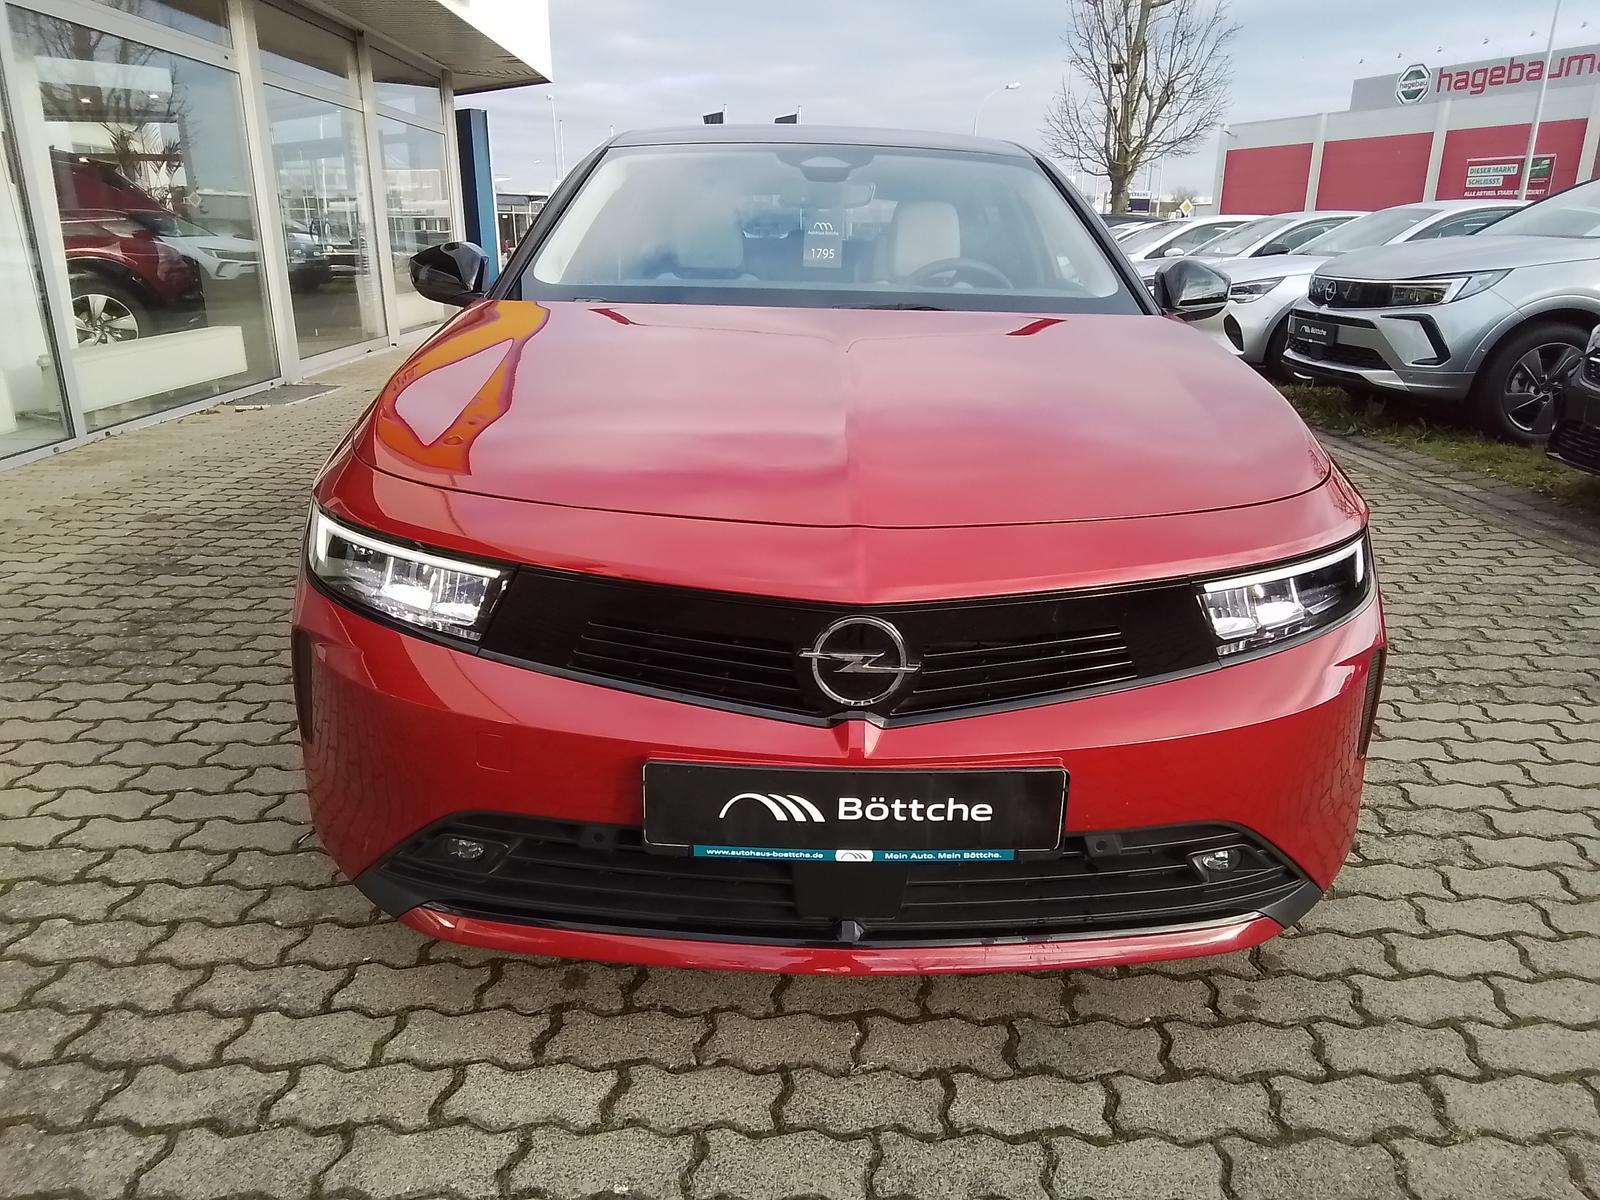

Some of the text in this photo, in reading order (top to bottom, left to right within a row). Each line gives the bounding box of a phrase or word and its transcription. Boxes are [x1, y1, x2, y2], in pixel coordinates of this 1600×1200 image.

[1400, 80, 1428, 89] hagebau
[811, 248, 835, 259] 1795
[838, 797, 993, 821] Böttche
[706, 849, 824, 859] www.autohaus-boettche.de
[884, 852, 908, 860] Mein
[910, 852, 935, 860] Auto.
[963, 850, 1002, 859] Böttche.
